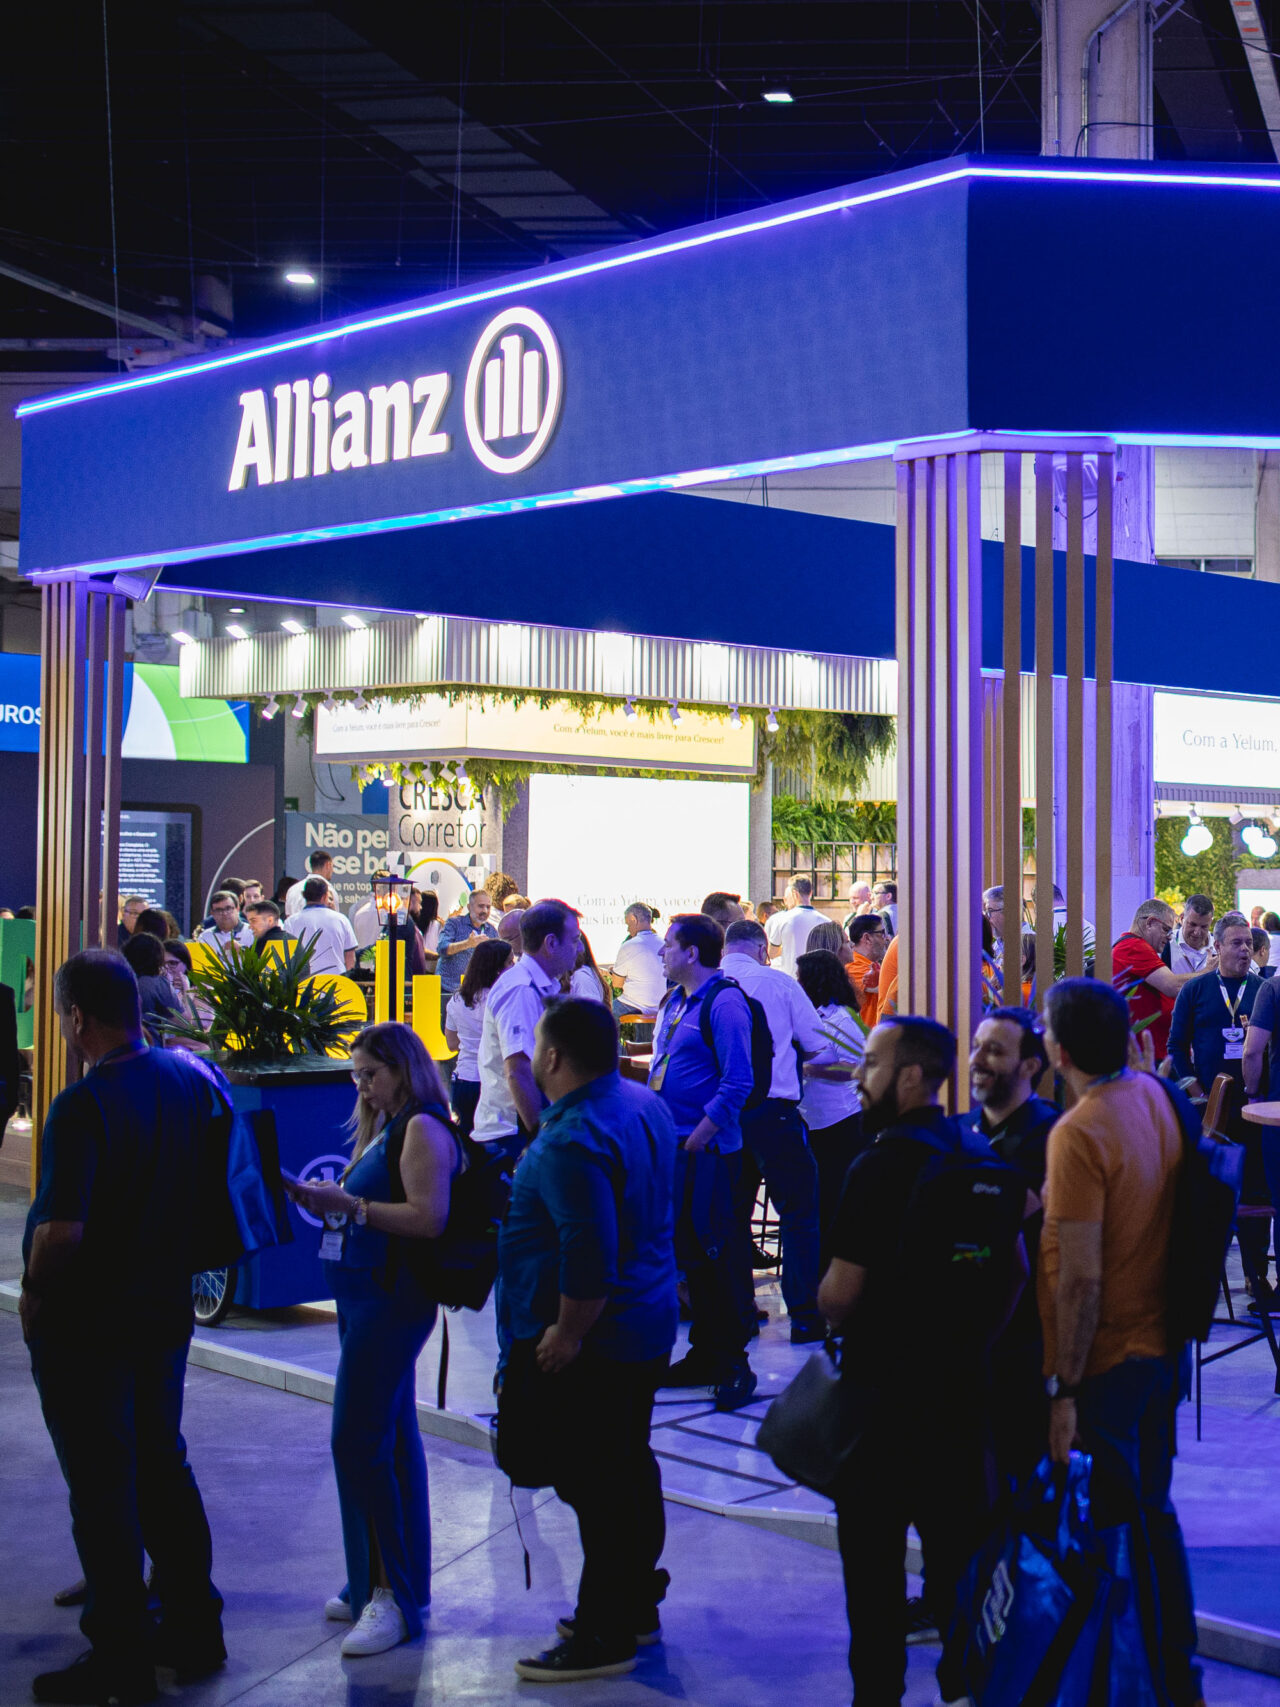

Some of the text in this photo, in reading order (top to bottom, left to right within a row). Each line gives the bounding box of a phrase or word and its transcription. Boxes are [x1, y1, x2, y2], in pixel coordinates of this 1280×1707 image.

[228, 372, 450, 492] Allianz
[553, 724, 573, 734] Com
[610, 728, 628, 737] você
[636, 731, 655, 740] mais
[657, 731, 673, 741] livre
[675, 734, 692, 744] para
[1182, 729, 1215, 748] Com
[1219, 736, 1228, 749] a
[1232, 732, 1278, 753] Yelum,
[305, 822, 354, 848] Não
[398, 814, 487, 848] Corretor
